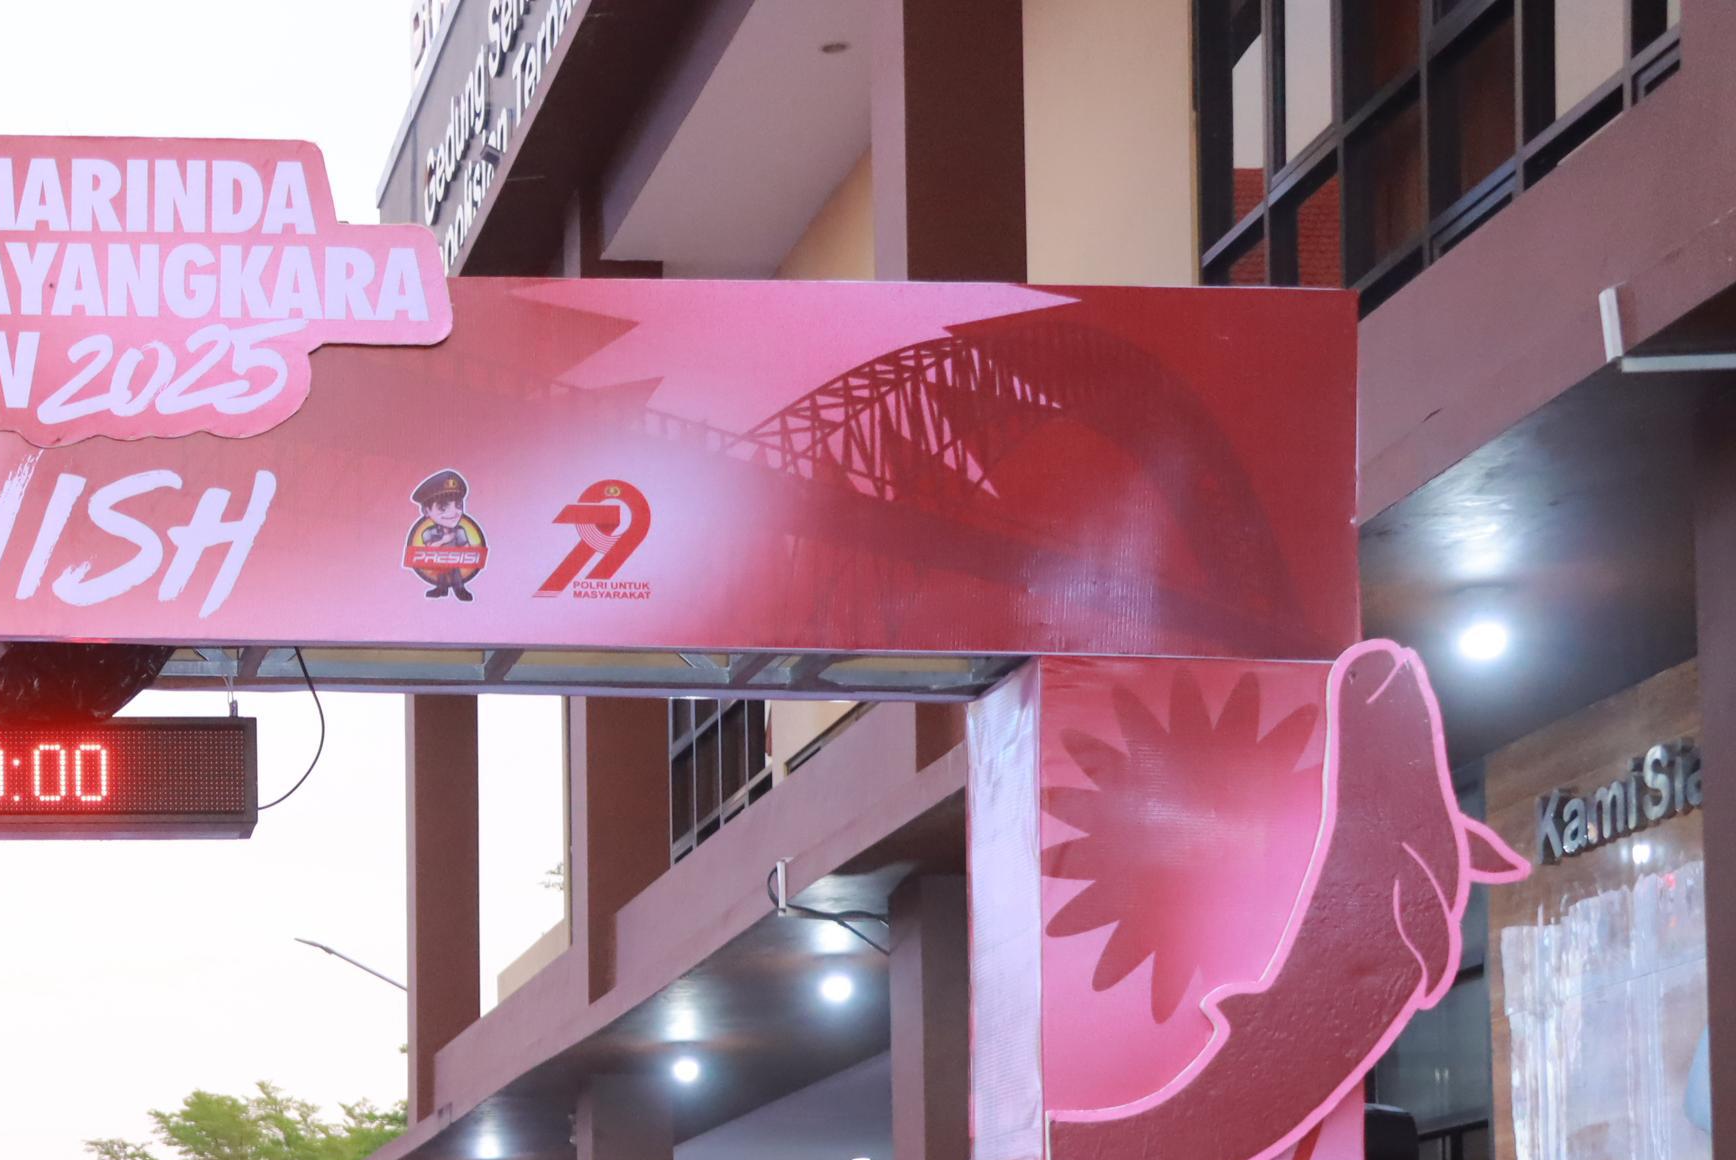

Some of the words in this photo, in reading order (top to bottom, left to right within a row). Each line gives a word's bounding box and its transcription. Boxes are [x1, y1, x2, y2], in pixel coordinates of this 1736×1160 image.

[37, 319, 309, 425] 2025
[573, 581, 607, 590] POLRI
[611, 581, 650, 590] UNTUK
[573, 590, 651, 600] MASYARAKAT
